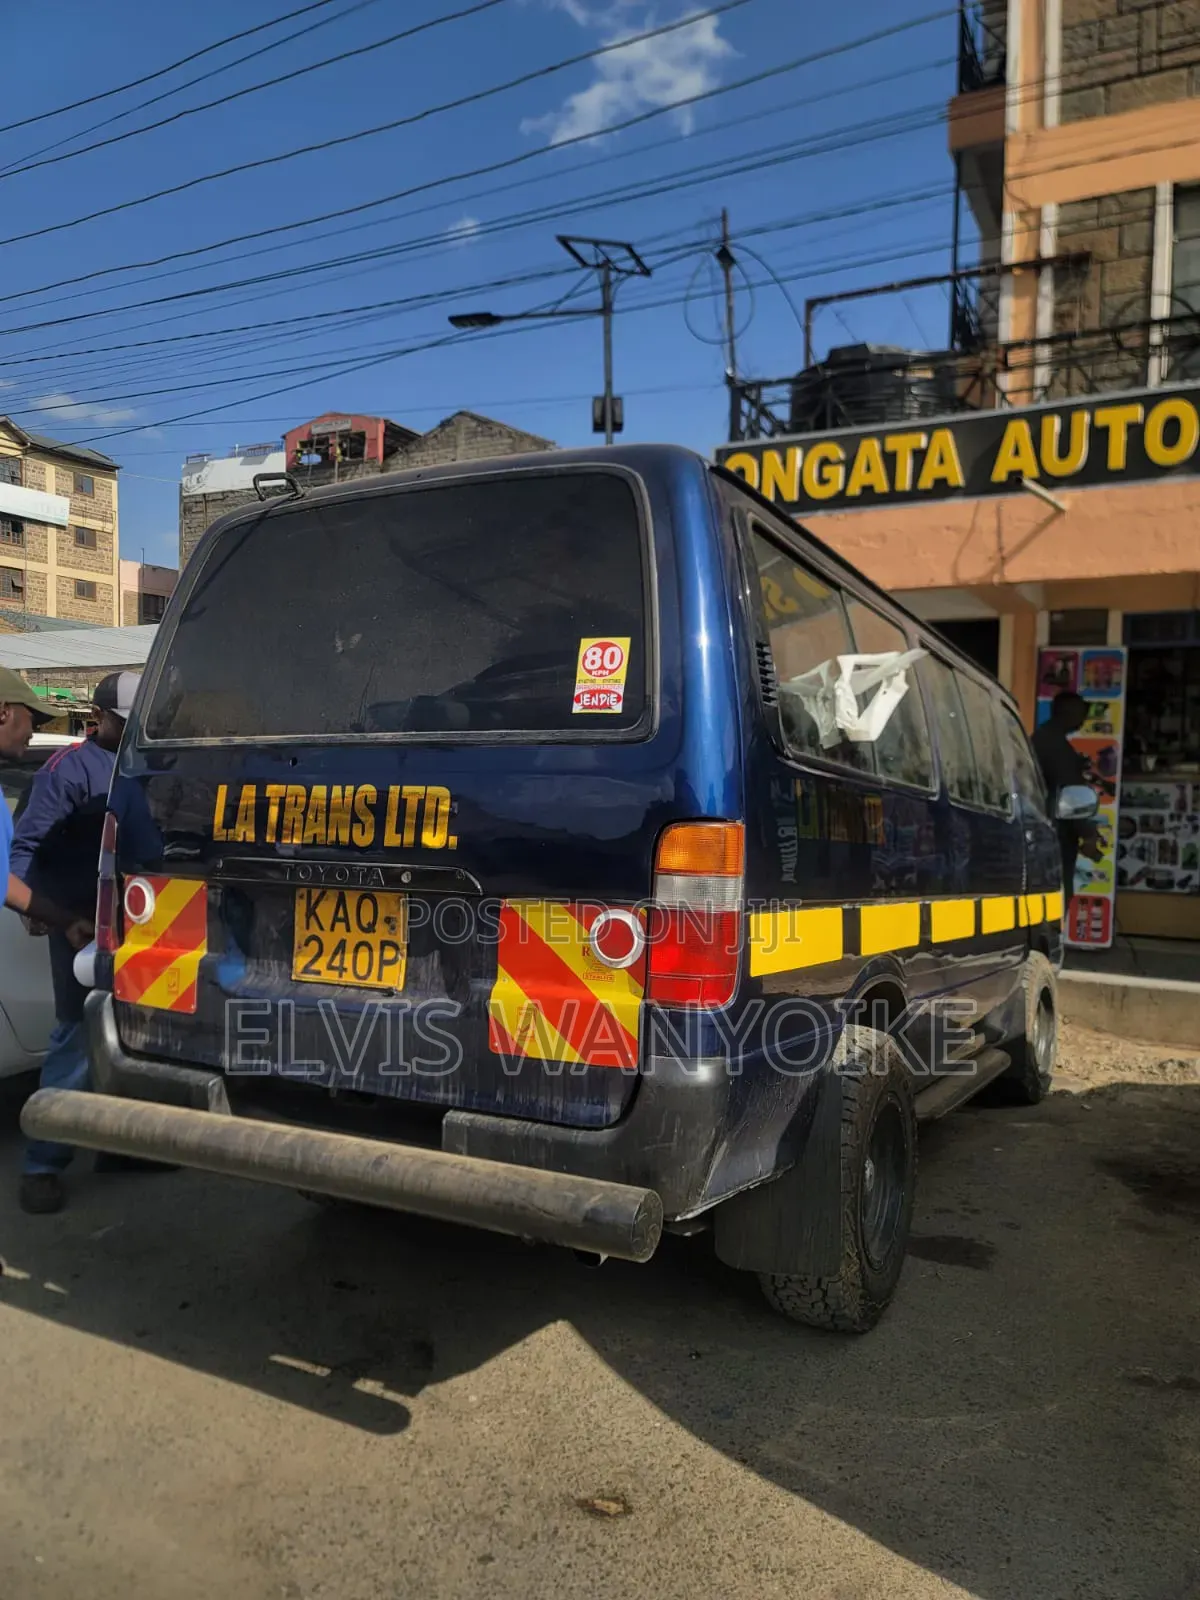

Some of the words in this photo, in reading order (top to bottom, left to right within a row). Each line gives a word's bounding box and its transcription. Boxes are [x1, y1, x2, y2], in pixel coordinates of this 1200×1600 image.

[724, 428, 965, 502] ONGATA
[991, 397, 1199, 484] AUTO
[584, 646, 622, 670] 80
[212, 784, 257, 843] L.A
[265, 784, 377, 848] TRANS
[384, 785, 458, 850] LTD.
[281, 863, 385, 887] TOYOTA
[304, 889, 380, 934] KAQ
[300, 935, 401, 982] 240P
